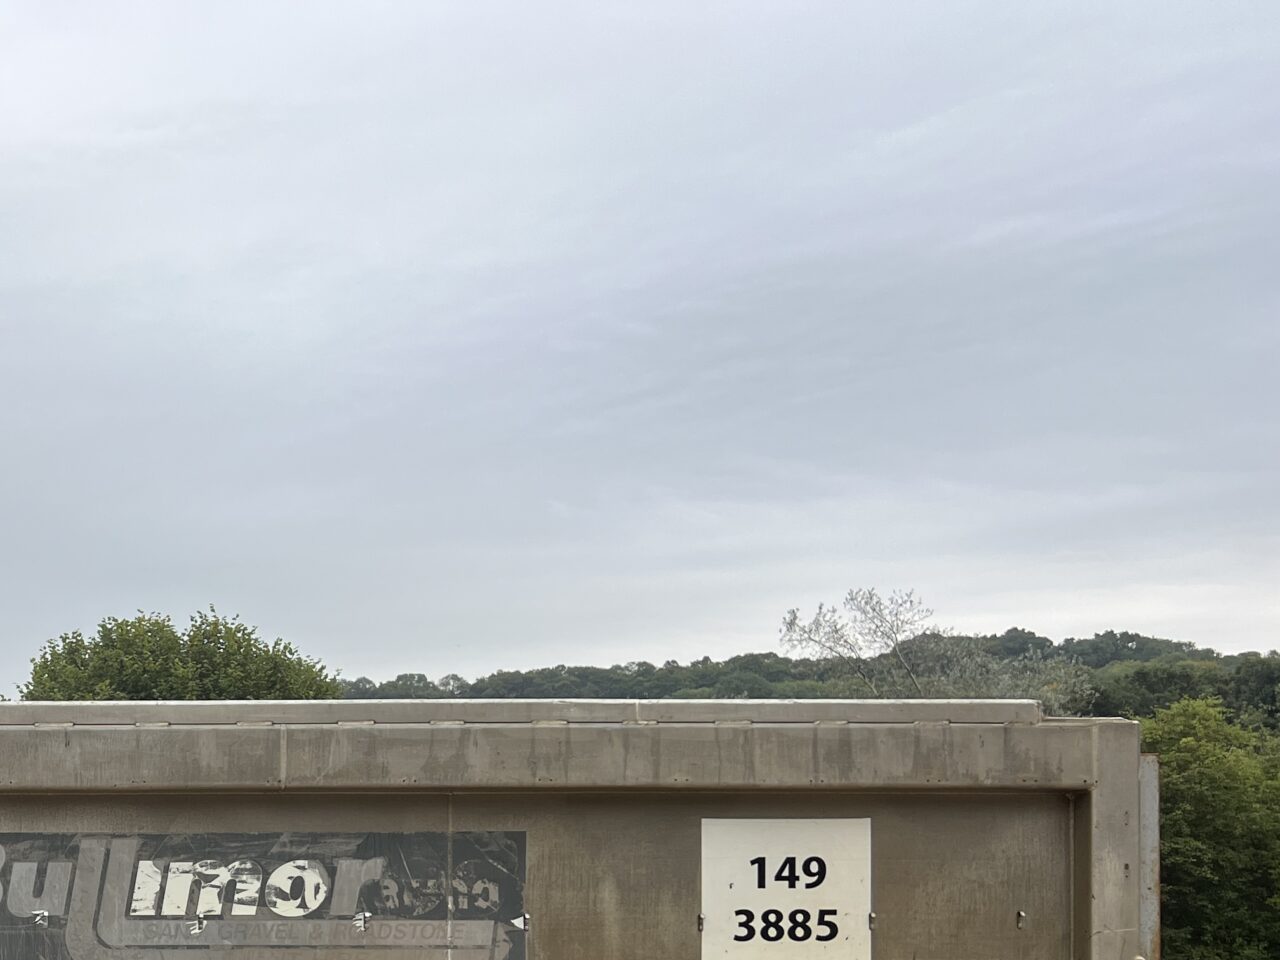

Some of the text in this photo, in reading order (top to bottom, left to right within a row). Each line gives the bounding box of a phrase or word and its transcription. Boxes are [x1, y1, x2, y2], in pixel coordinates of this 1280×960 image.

[750, 856, 827, 889] 149
[221, 922, 299, 940] GRAVEL
[733, 909, 839, 942] 3885
